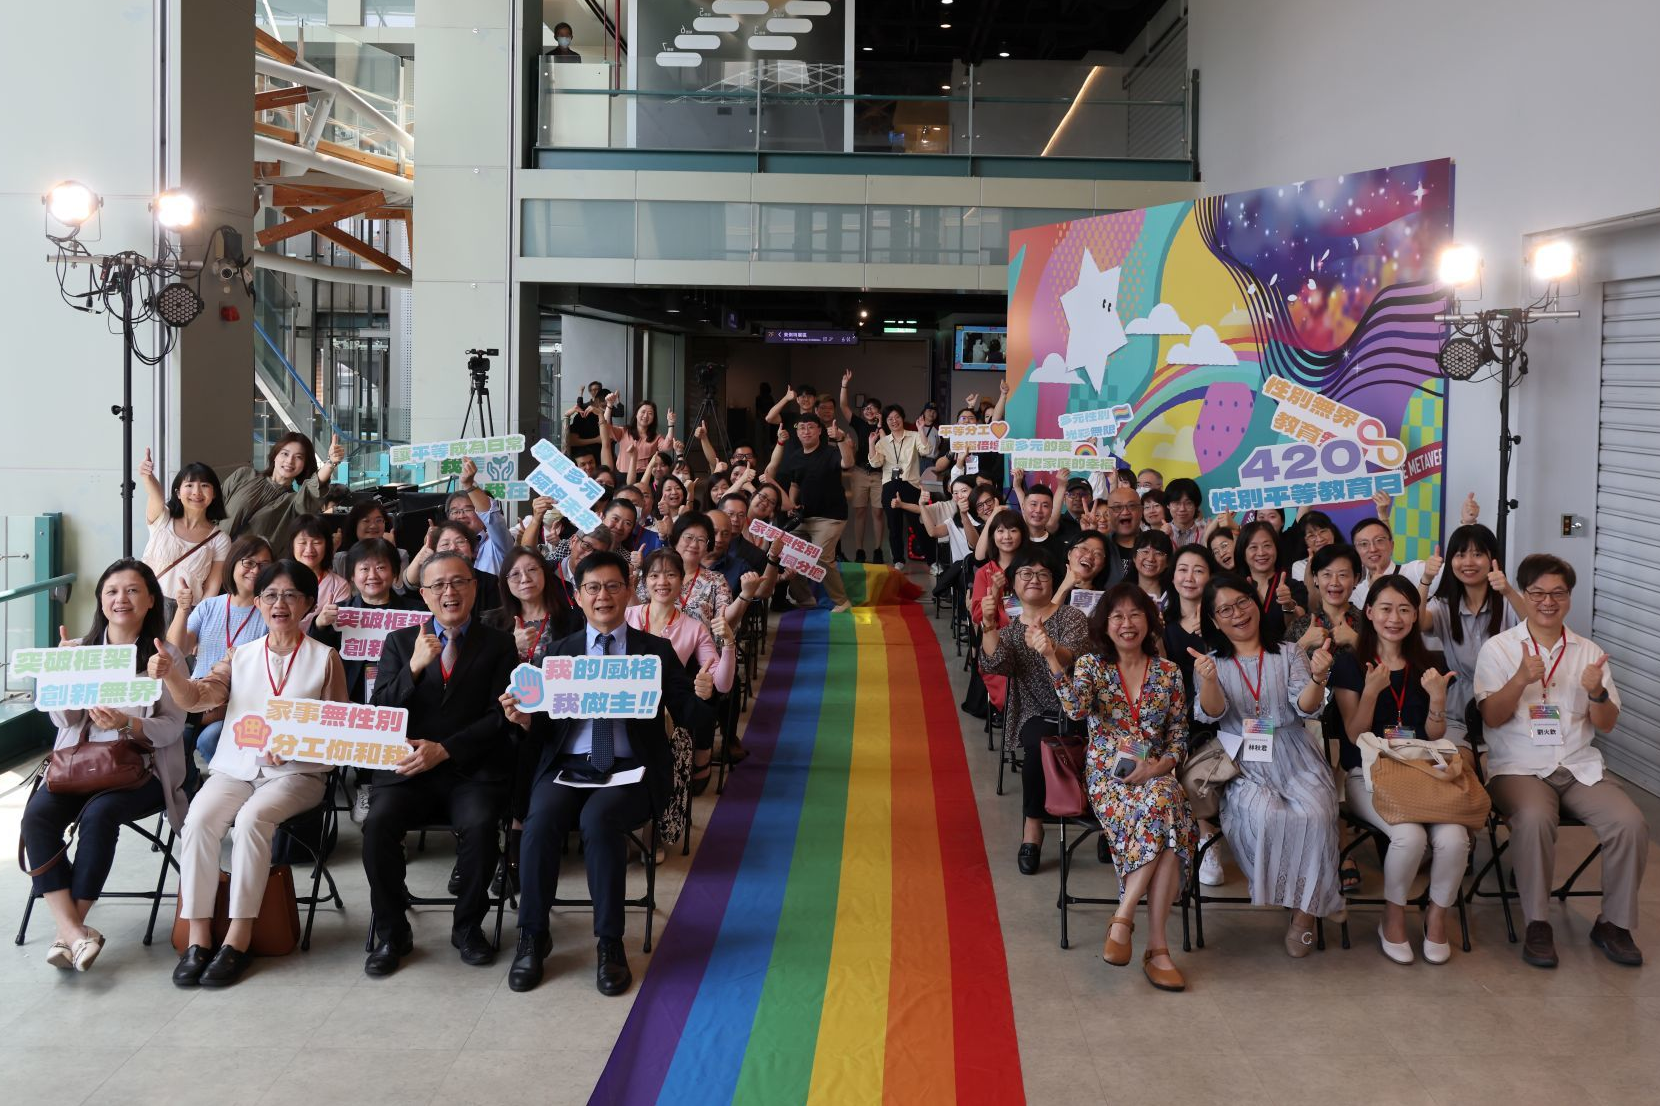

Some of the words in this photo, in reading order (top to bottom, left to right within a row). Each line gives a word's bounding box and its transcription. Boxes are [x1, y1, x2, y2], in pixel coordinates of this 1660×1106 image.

[1264, 375, 1360, 428] 性別無界
[939, 425, 990, 436] 平等分工
[1060, 410, 1110, 426] 多元性別
[393, 436, 523, 462] 讓平等成為日常
[1001, 440, 1072, 452] 讓多元的愛
[534, 441, 602, 500] 尊重多元
[1241, 439, 1361, 483] 420
[478, 482, 529, 499] 我在
[1211, 473, 1403, 511] 性別平等教育日
[779, 552, 824, 580] 同分擔
[14, 648, 132, 674] 突破框架
[545, 658, 657, 680] 我的風格
[40, 680, 157, 706] 創新無界
[266, 700, 404, 732] 家事無性別
[270, 733, 409, 766] 分工你和我
